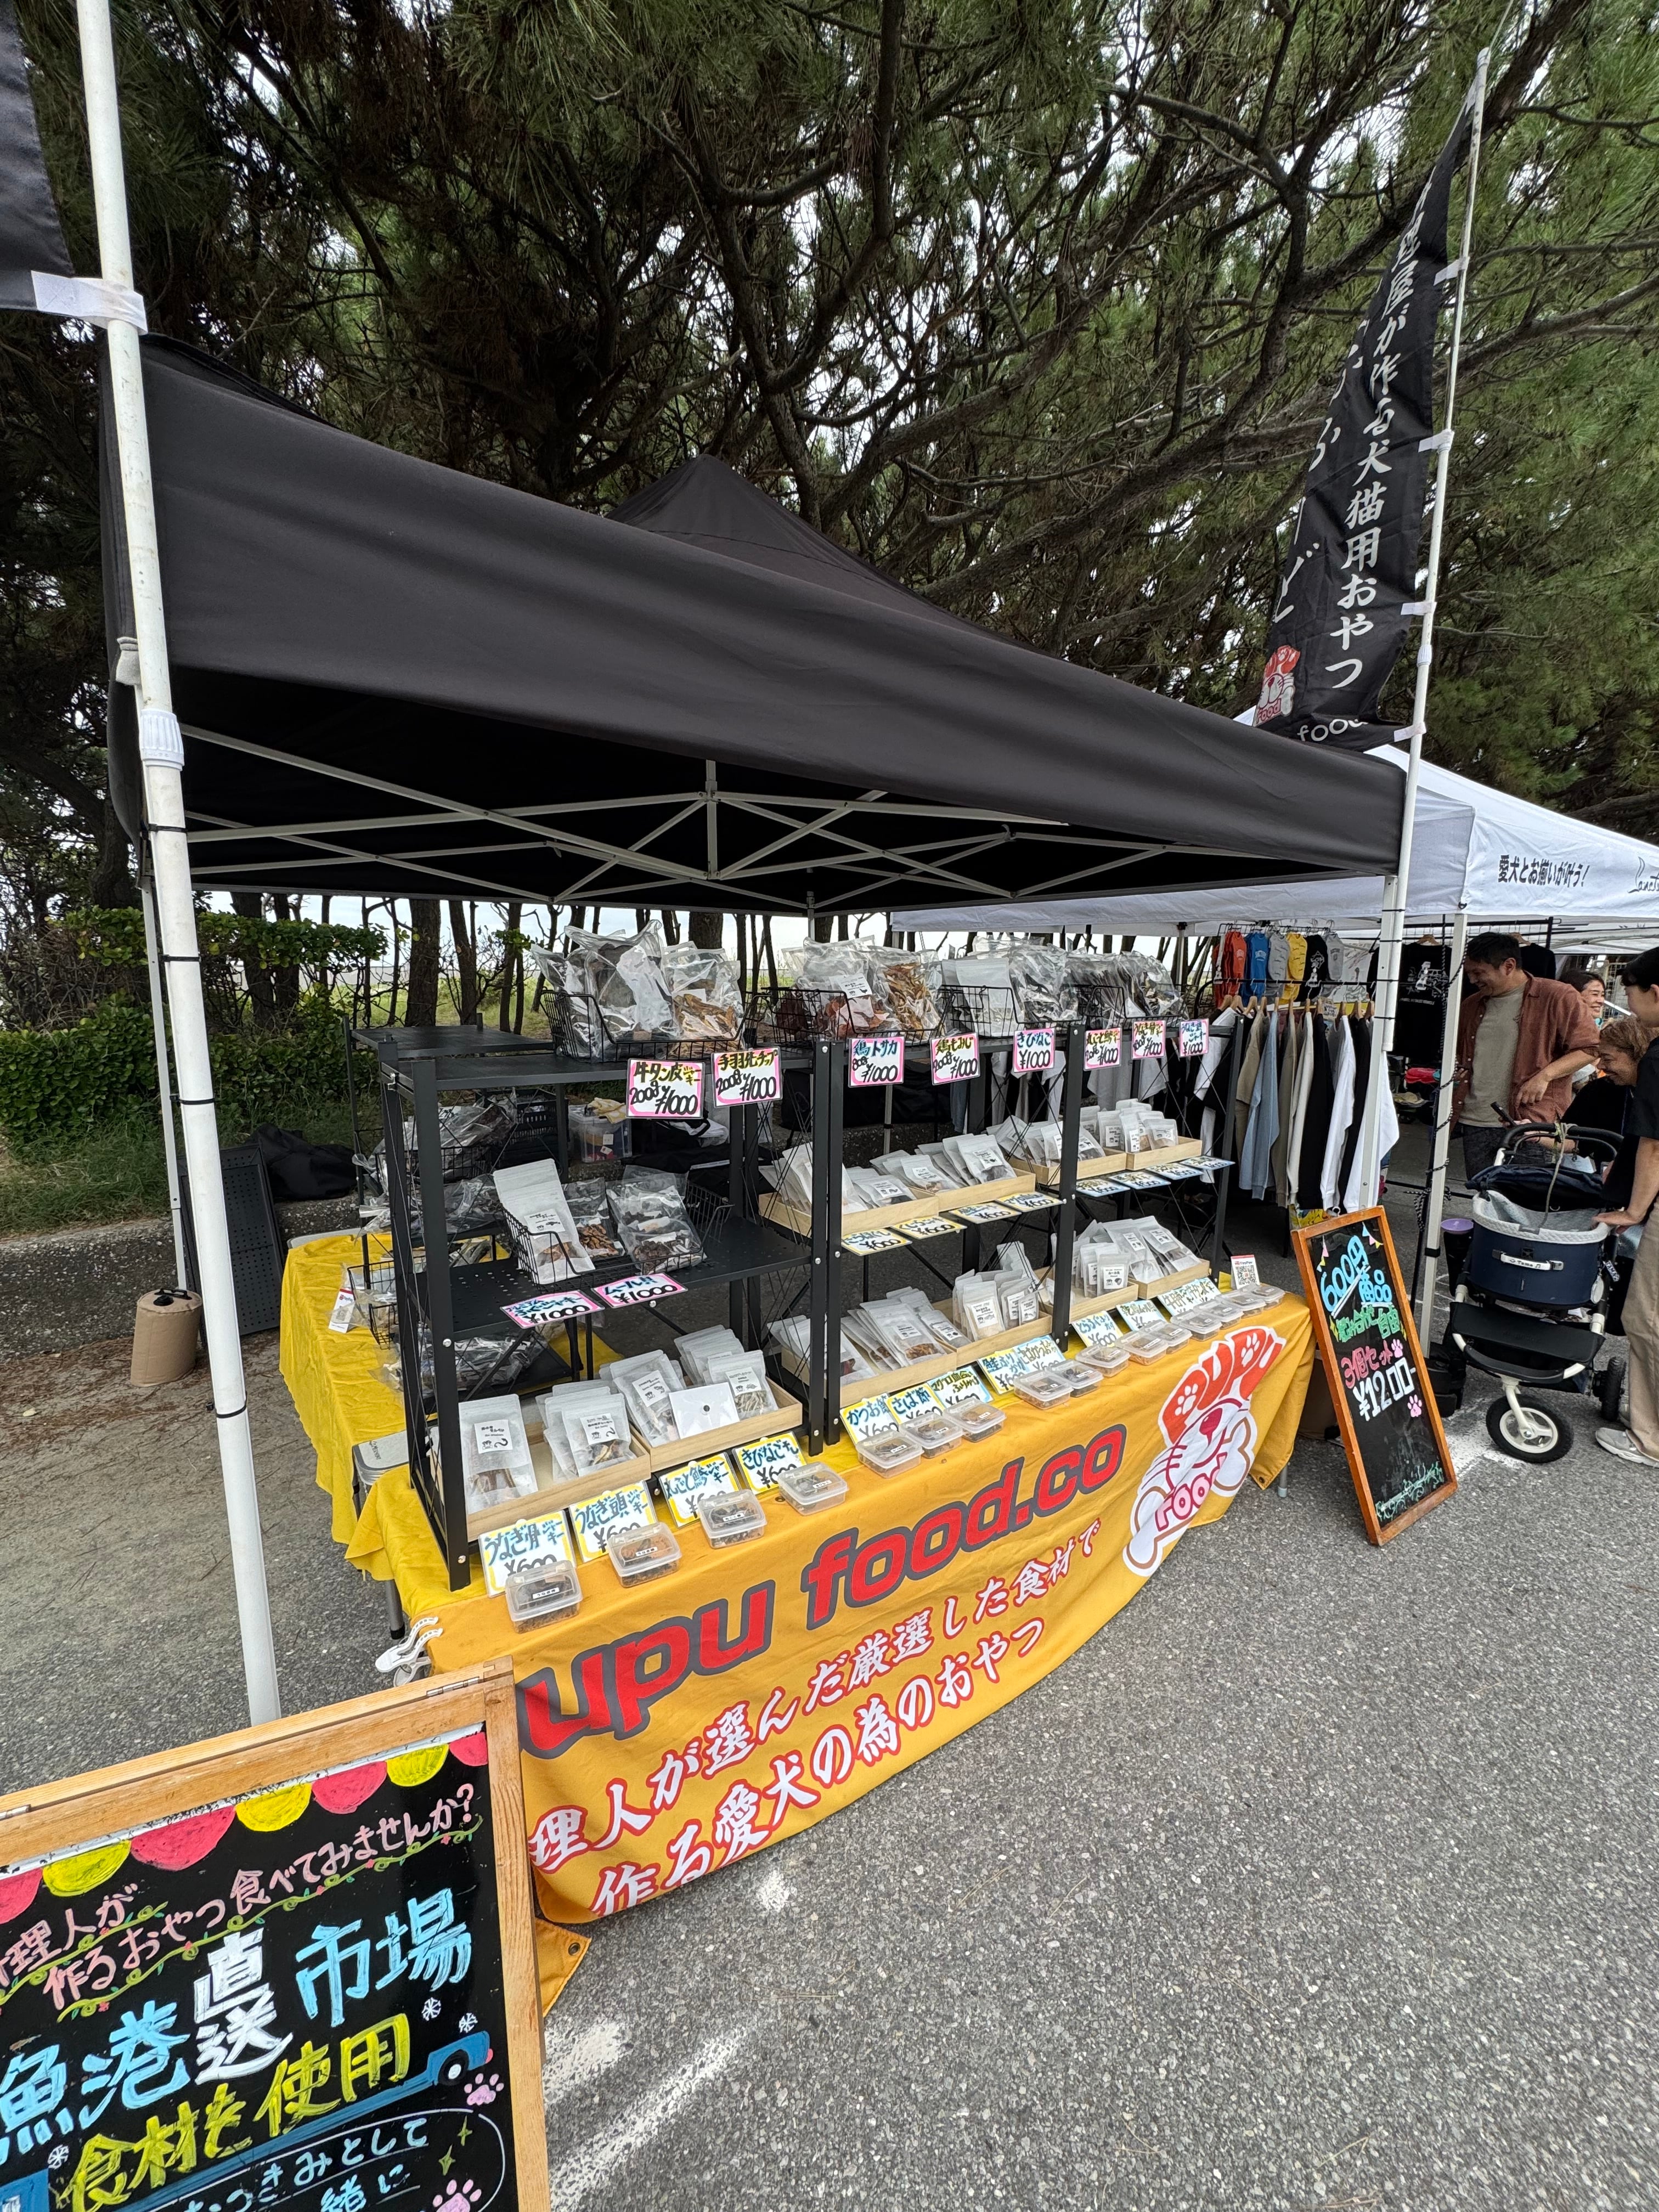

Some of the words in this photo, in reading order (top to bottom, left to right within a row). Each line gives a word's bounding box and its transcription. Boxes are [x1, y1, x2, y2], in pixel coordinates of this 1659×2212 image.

[935, 1036, 973, 1056] 鶏もみじ
[1017, 1031, 1053, 1048] きびなご
[718, 1049, 777, 1071] 手羽先チップ
[950, 1056, 978, 1079] ¥1000
[1019, 1049, 1051, 1069] ¥1000
[861, 1063, 898, 1082] ¥1000
[740, 1073, 776, 1101] ¥1000
[655, 1085, 698, 1115] ¥1000
[1022, 1199, 1053, 1207] ¥600
[974, 1211, 1011, 1219] ¥600
[911, 1224, 956, 1235] ¥600
[859, 1239, 901, 1250] ¥600
[605, 1276, 658, 1295] ムール貝
[613, 1285, 679, 1304] ¥1000
[522, 1305, 590, 1324] ¥1000
[805, 1423, 1127, 1630] food.co
[527, 1516, 1102, 1873] 理人が選んだ厳選した食材で
[591, 1616, 1045, 1917] 作る愛犬の為のおやつ
[0, 1883, 138, 1987] 理人が
